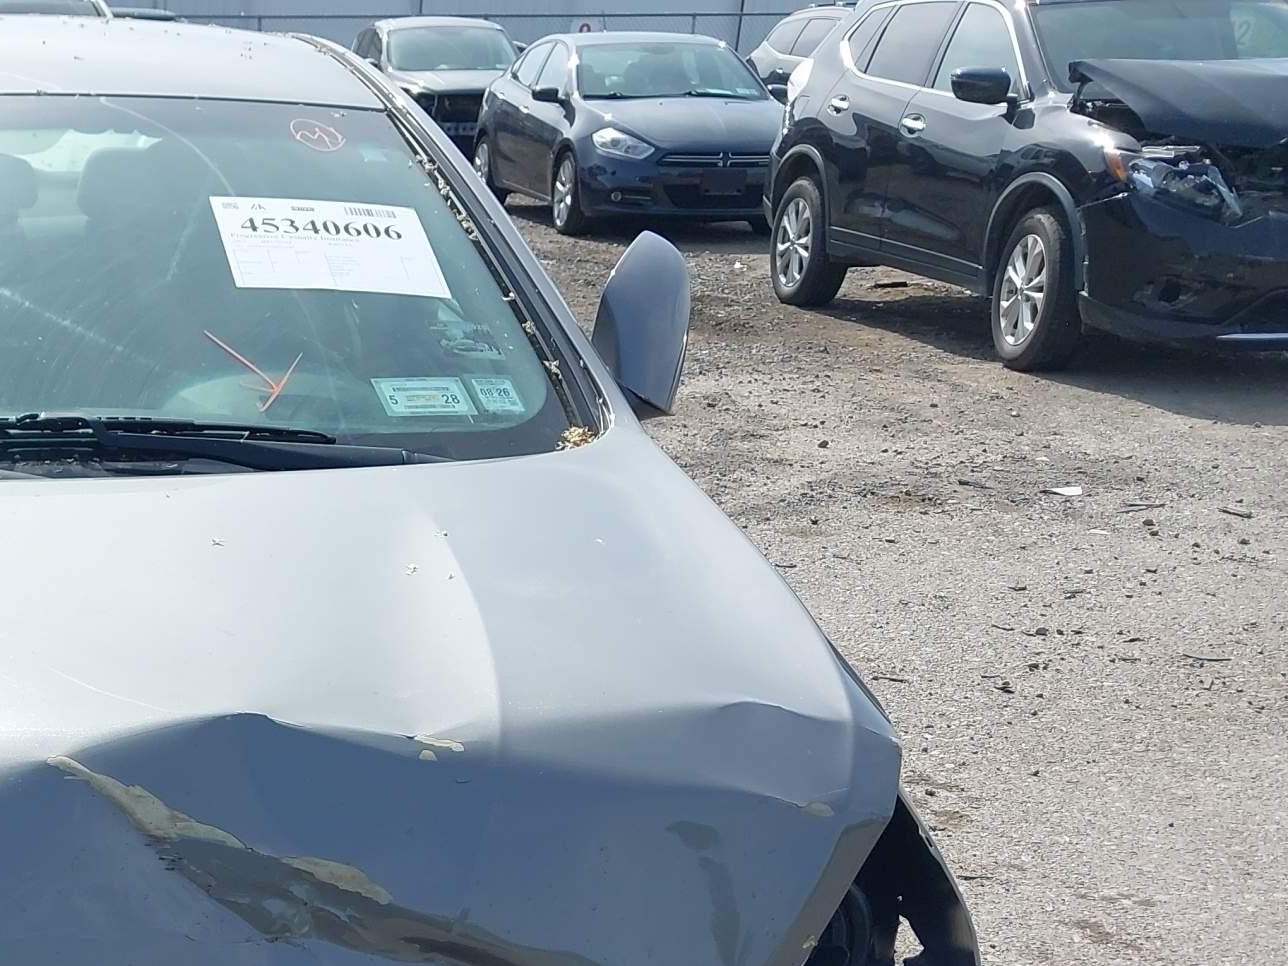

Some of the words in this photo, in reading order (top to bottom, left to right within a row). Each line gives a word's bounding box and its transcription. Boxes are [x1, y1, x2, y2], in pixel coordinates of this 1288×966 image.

[240, 216, 403, 241] 45340606
[495, 387, 511, 397] 26
[388, 394, 399, 405] 5
[441, 393, 461, 405] 28
